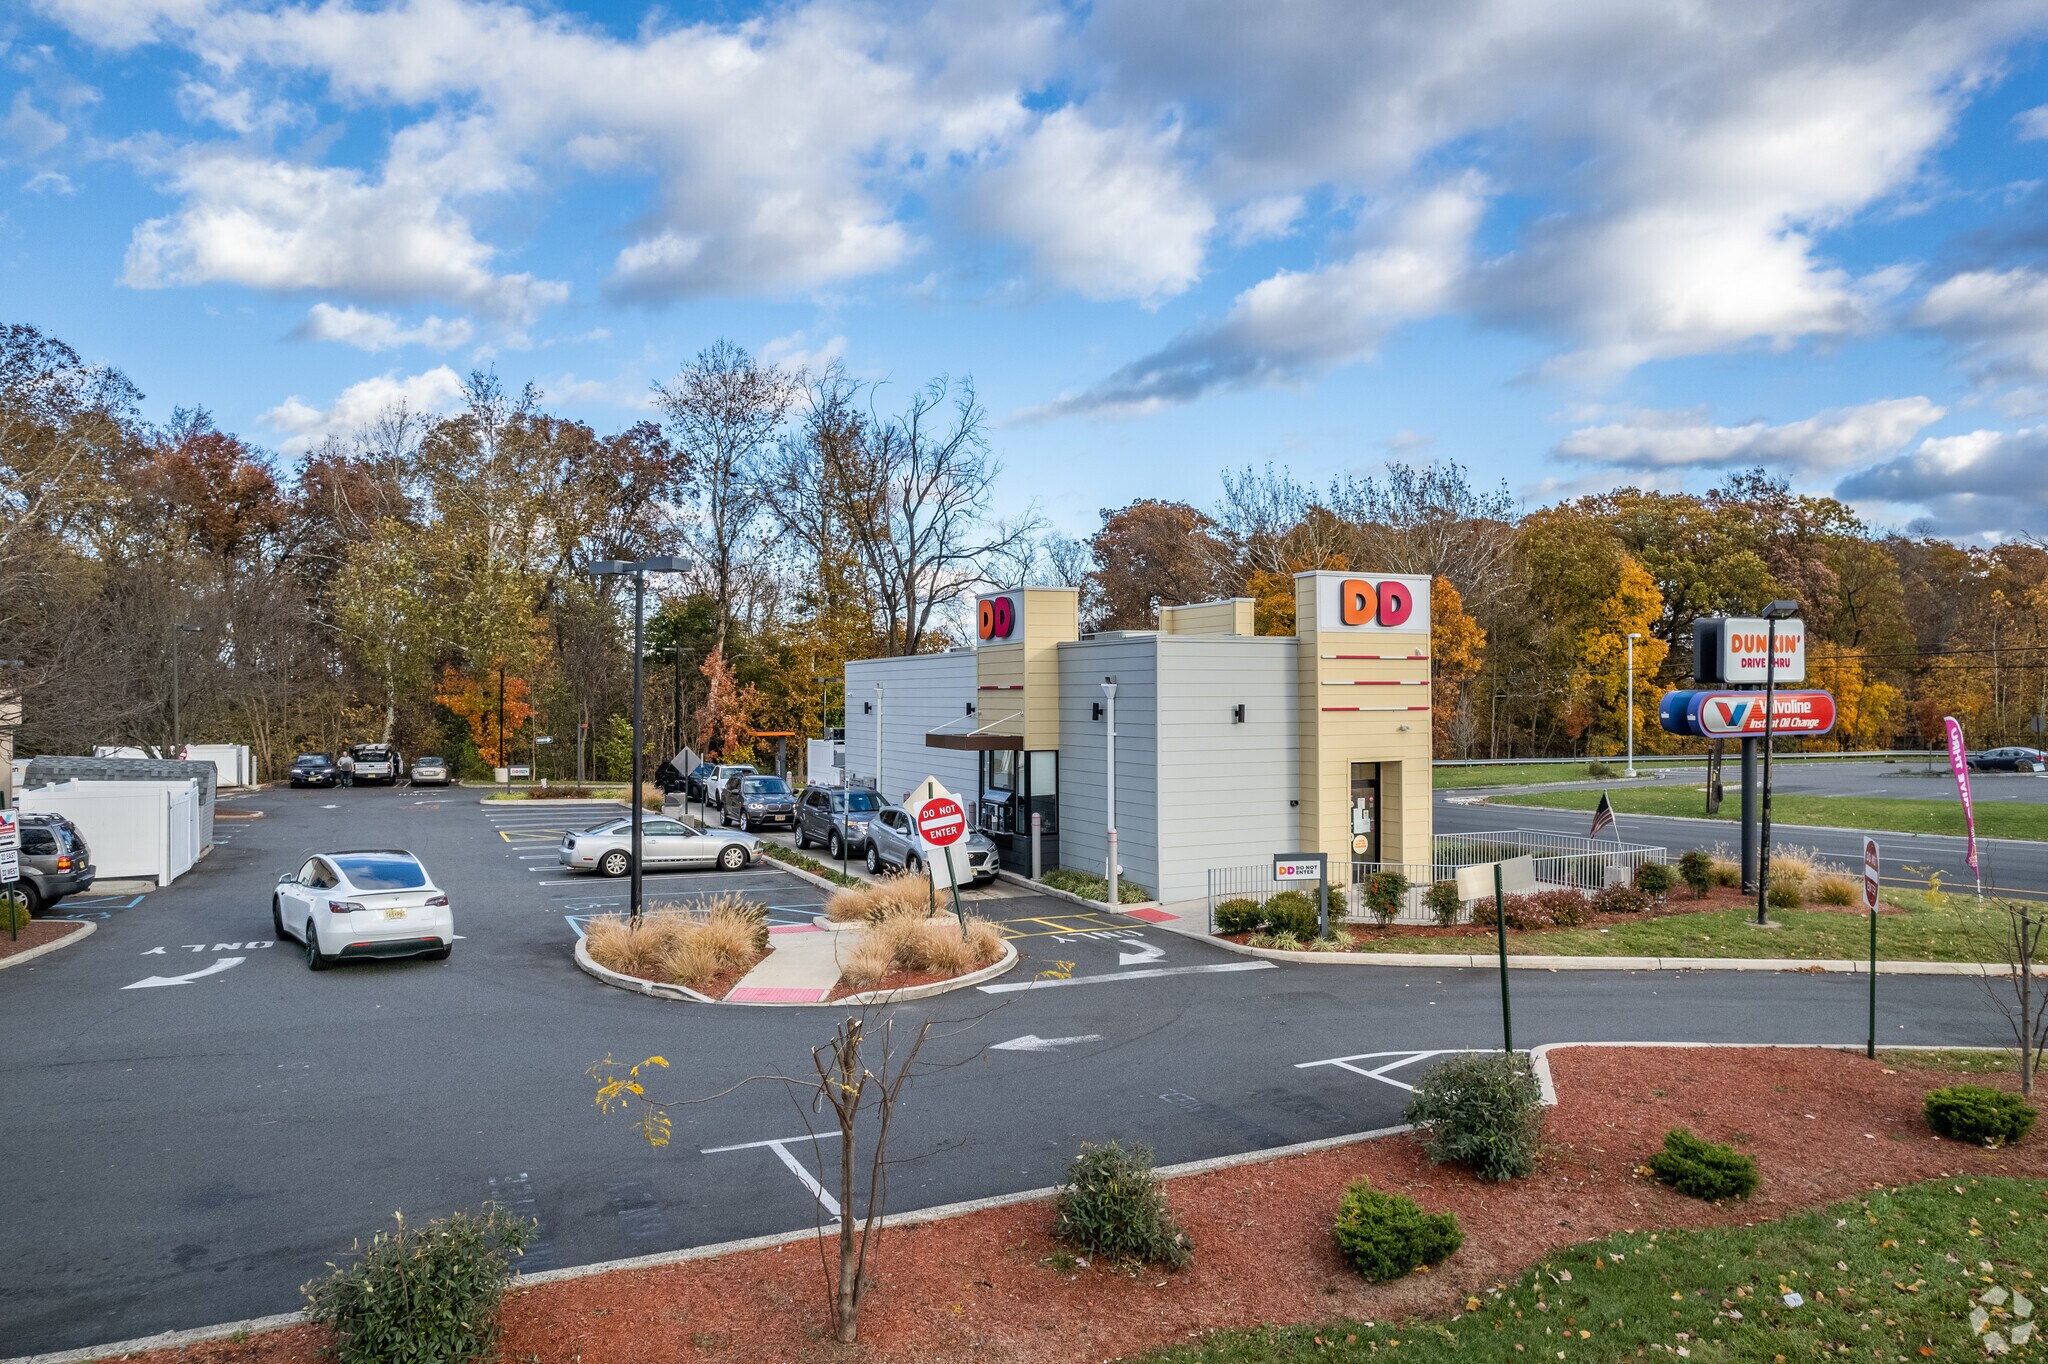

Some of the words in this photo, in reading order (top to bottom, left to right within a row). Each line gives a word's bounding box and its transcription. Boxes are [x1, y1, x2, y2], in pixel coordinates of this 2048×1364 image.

[1340, 579, 1412, 627] DD
[978, 596, 1014, 639] DD
[1741, 657, 1766, 668] DRIVE
[1773, 657, 1791, 668] HRU
[1758, 699, 1812, 714] Vlvoline
[1749, 718, 1779, 729] Instnt
[1780, 717, 1789, 728] Oil
[1790, 717, 1820, 729] Change
[923, 809, 935, 819] DO
[939, 805, 956, 815] NOT
[930, 826, 957, 839] ENTER
[1279, 866, 1295, 875] DD
[139, 940, 275, 956] ONLY
